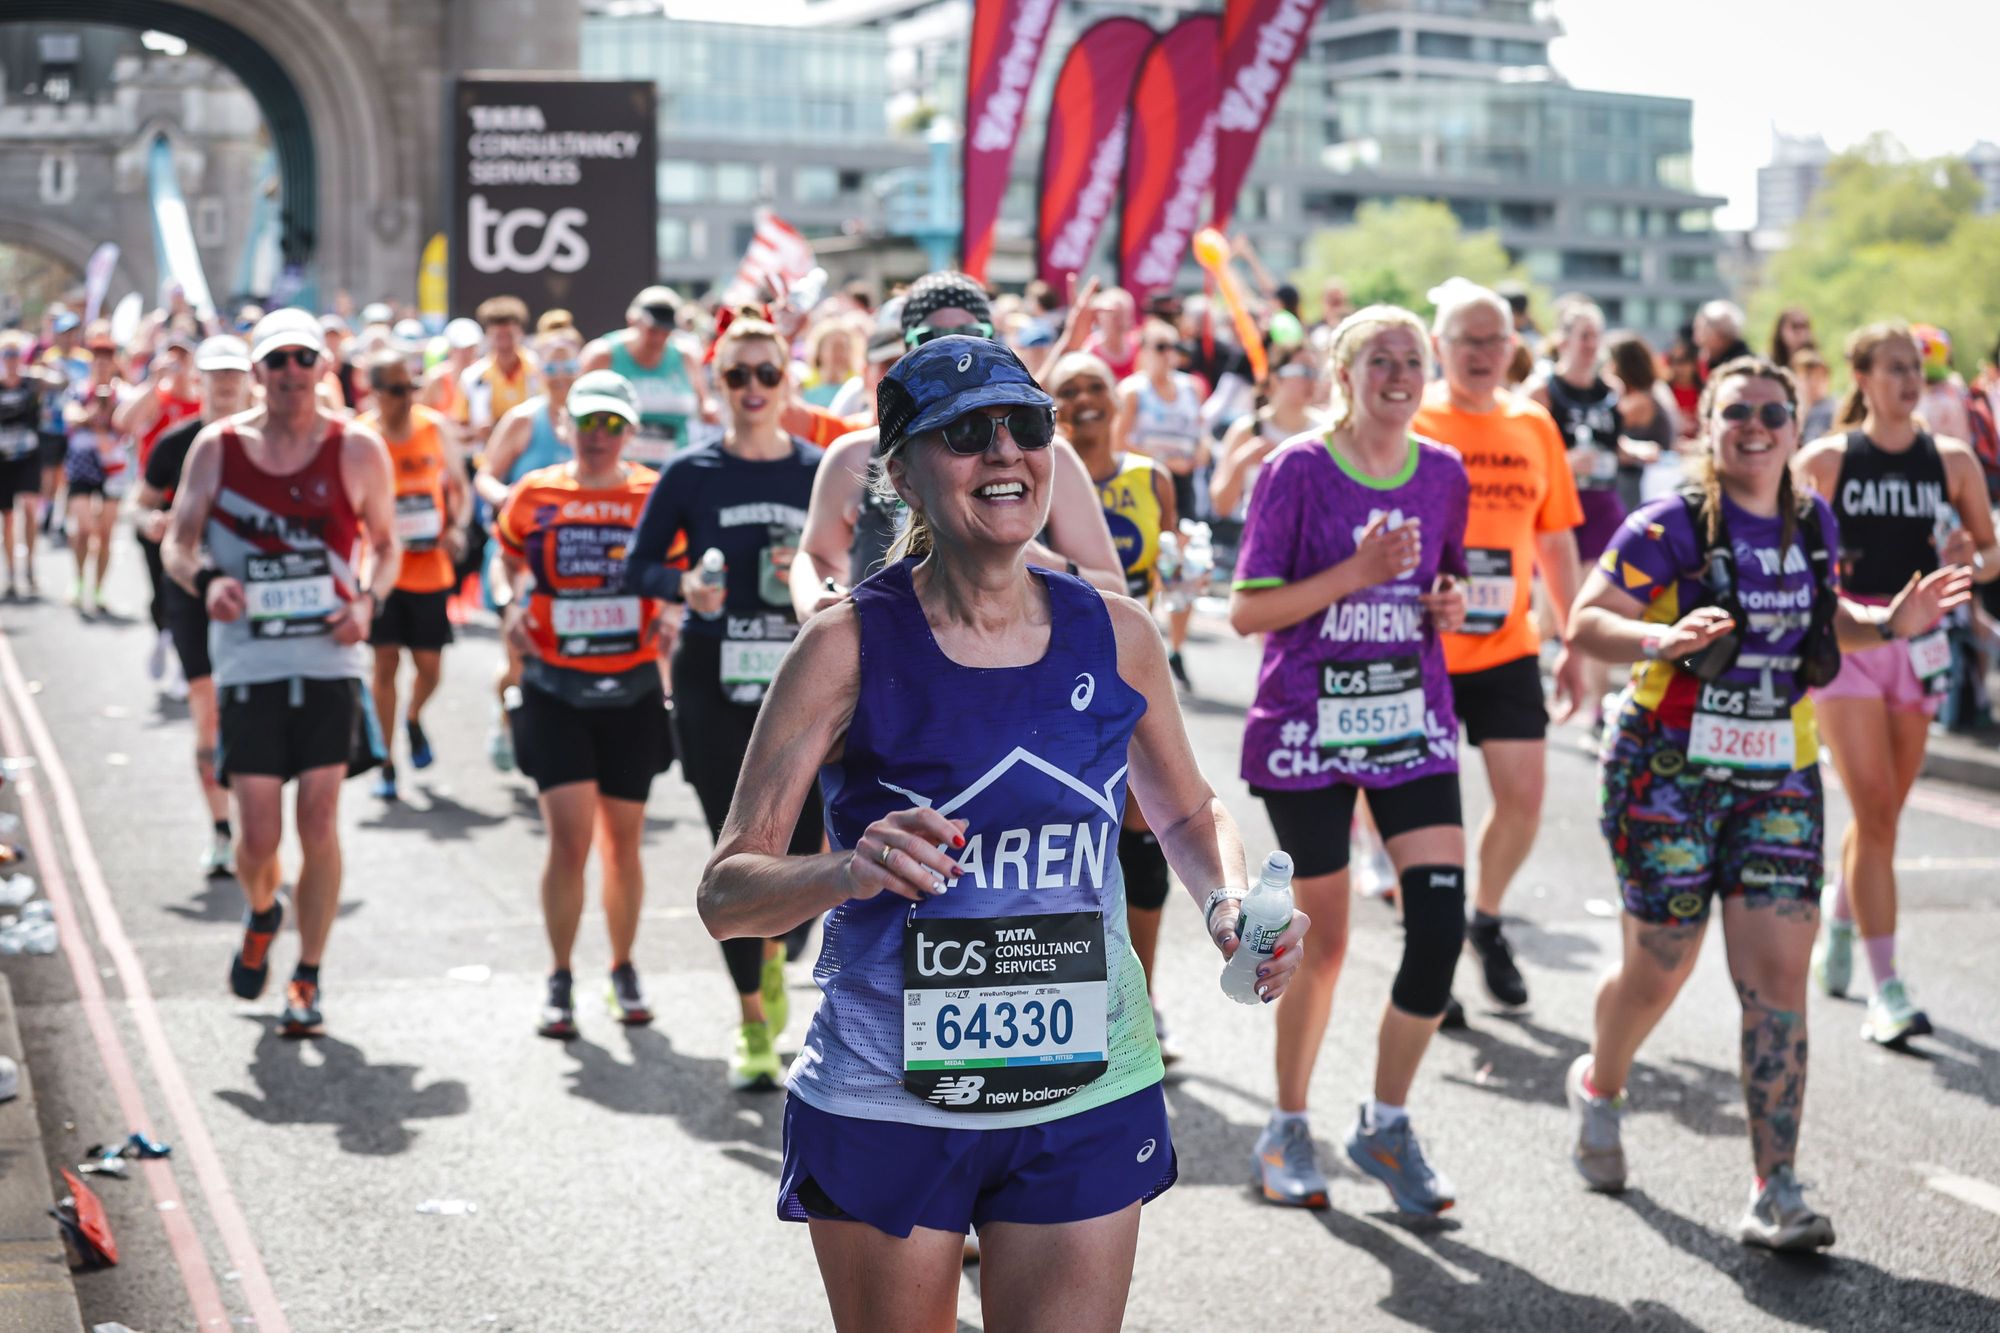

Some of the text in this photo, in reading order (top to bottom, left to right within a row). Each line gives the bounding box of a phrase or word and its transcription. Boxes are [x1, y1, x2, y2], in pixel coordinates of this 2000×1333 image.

[468, 105, 546, 131] TATA
[468, 132, 641, 159] CONSULTANCY
[468, 159, 581, 185] SERVICES
[468, 193, 590, 274] tcs
[562, 501, 633, 521] CATH
[1842, 479, 1943, 520] CAITLIN
[1324, 666, 1368, 695] tcs
[1701, 684, 1745, 714] tcs
[1338, 703, 1411, 734] 65573
[995, 928, 1036, 943] TATA
[916, 932, 987, 977] tcs
[995, 941, 1091, 958] CONSULTANCY
[995, 959, 1057, 974] SERVICES
[979, 989, 1029, 998] #WeRunTogether
[936, 998, 1074, 1050] 64330
[1055, 1053, 1074, 1061] FITTED
[985, 1091, 1020, 1105] new
